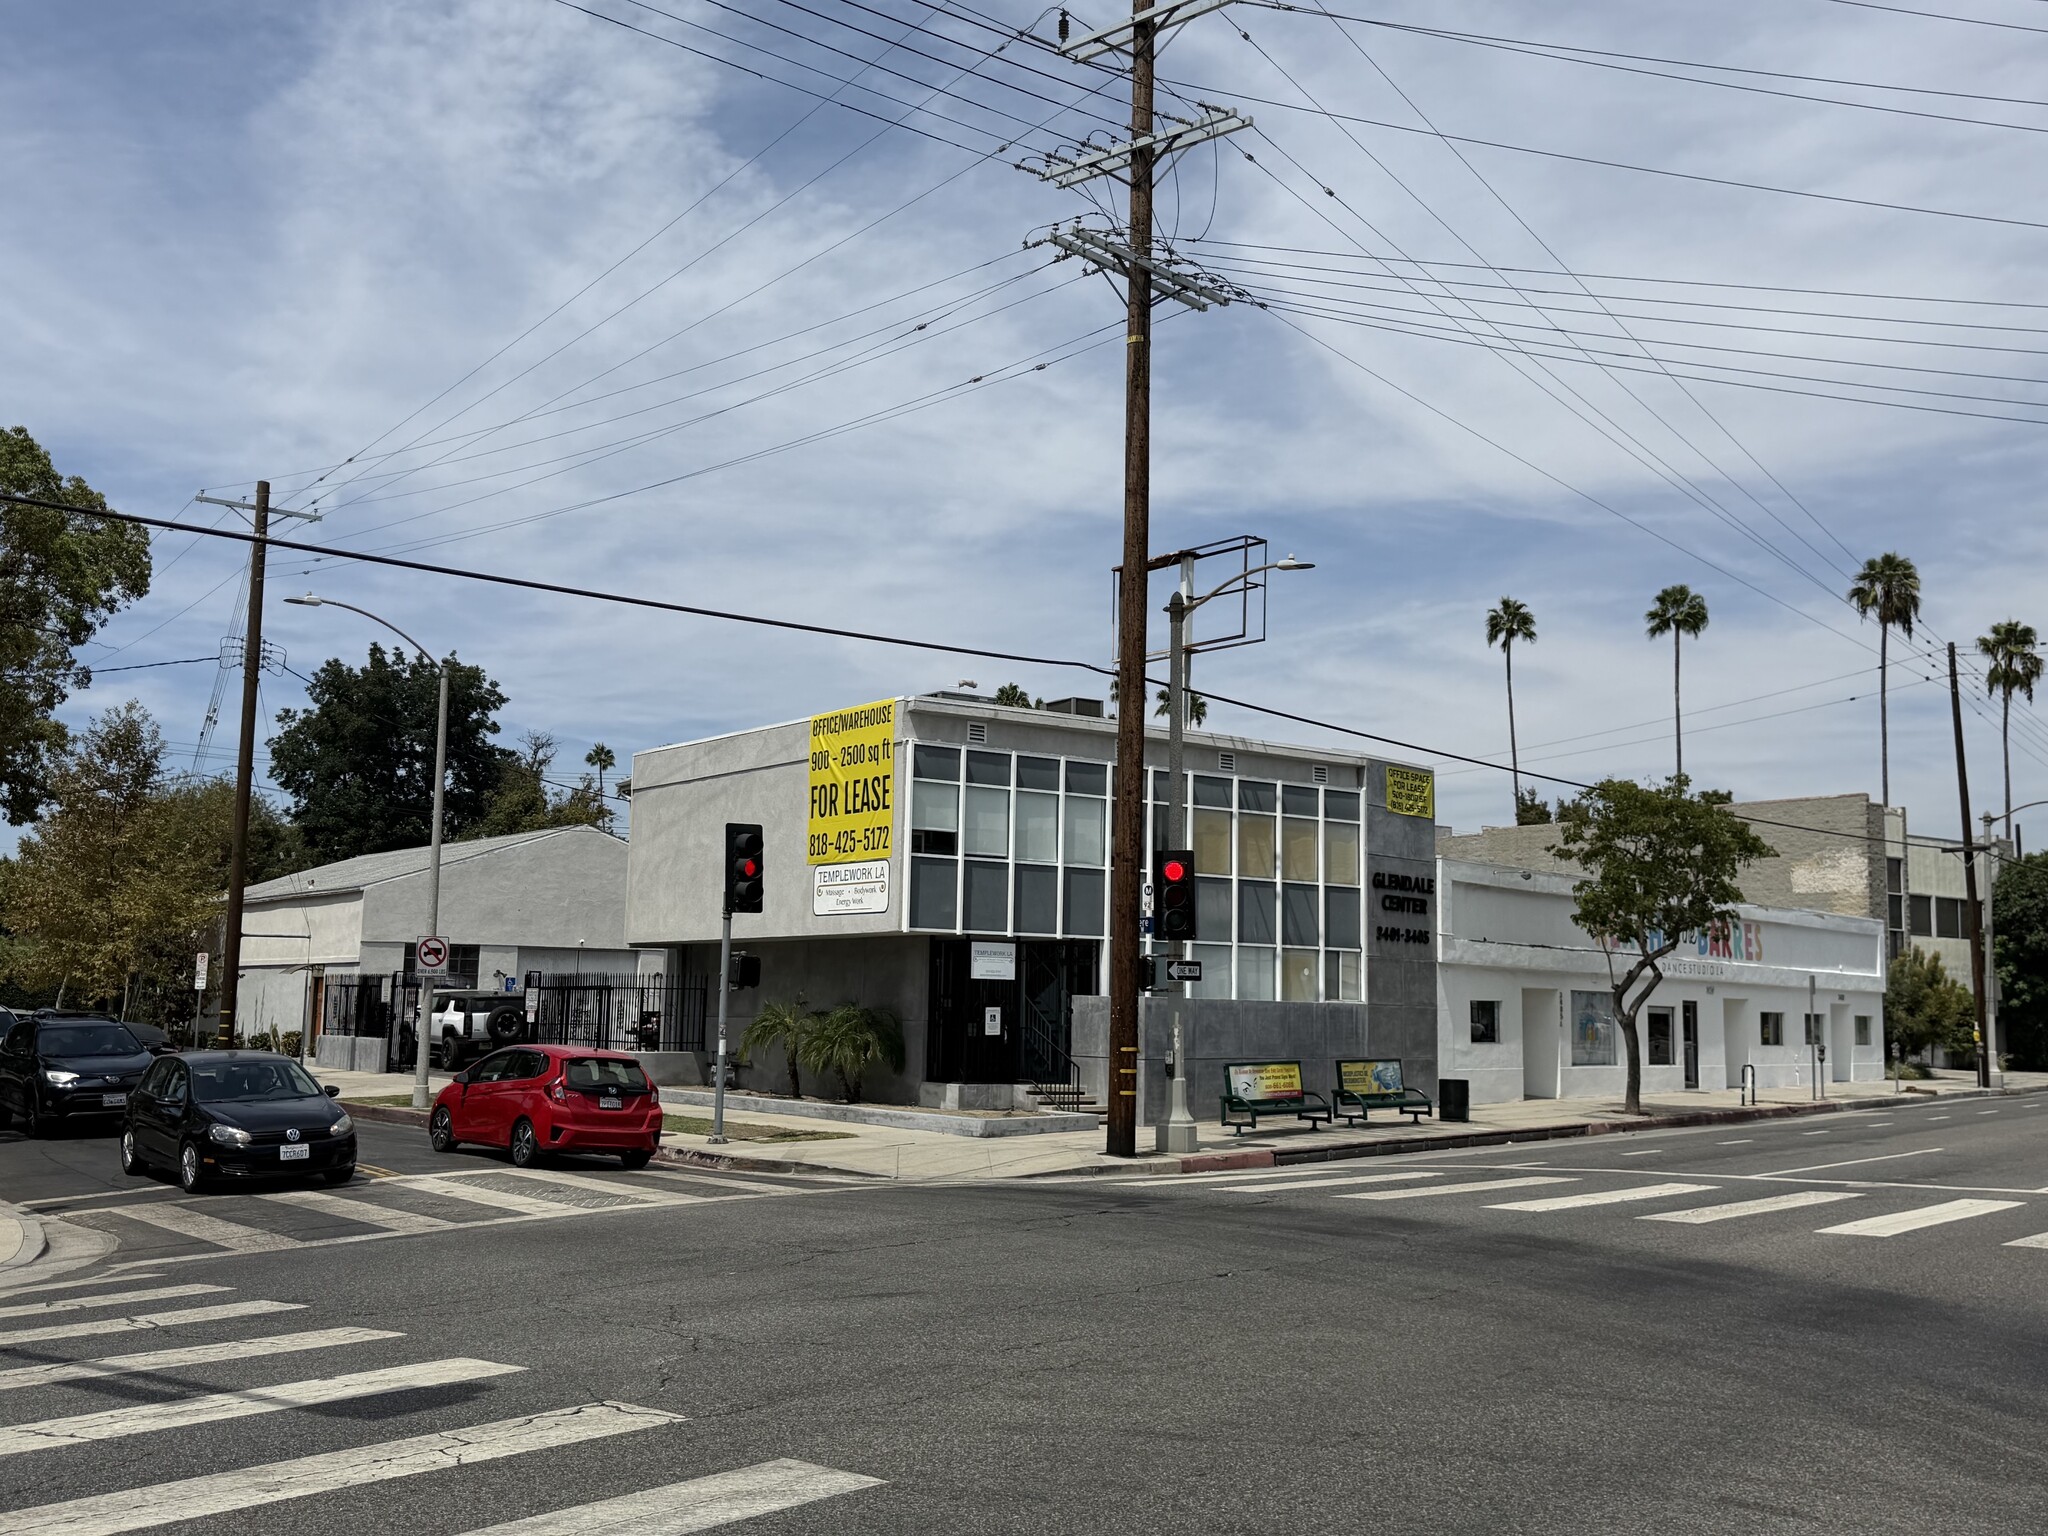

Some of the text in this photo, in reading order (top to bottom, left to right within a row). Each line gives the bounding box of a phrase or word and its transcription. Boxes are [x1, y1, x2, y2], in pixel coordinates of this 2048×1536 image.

[813, 705, 892, 736] OFFICE/WAREHOUSE
[811, 750, 829, 772] 900
[840, 743, 865, 768] 2500
[868, 744, 879, 766] sq
[882, 738, 891, 760] ft
[1388, 768, 1430, 784] OFFICE SPACE
[810, 774, 891, 819] FOR LEASE
[1394, 780, 1425, 794] FOR LEASE
[809, 826, 889, 856] 818-425-5172
[818, 866, 885, 884] TEMPLEWORK LA
[1372, 871, 1434, 894] GLENDALE
[826, 885, 877, 897] Massage Bodywork
[836, 898, 851, 907] Energy
[1381, 894, 1428, 915] CENTER
[1698, 916, 1763, 961] BARRES
[1662, 961, 1724, 976] DANCE STUDIO LA
